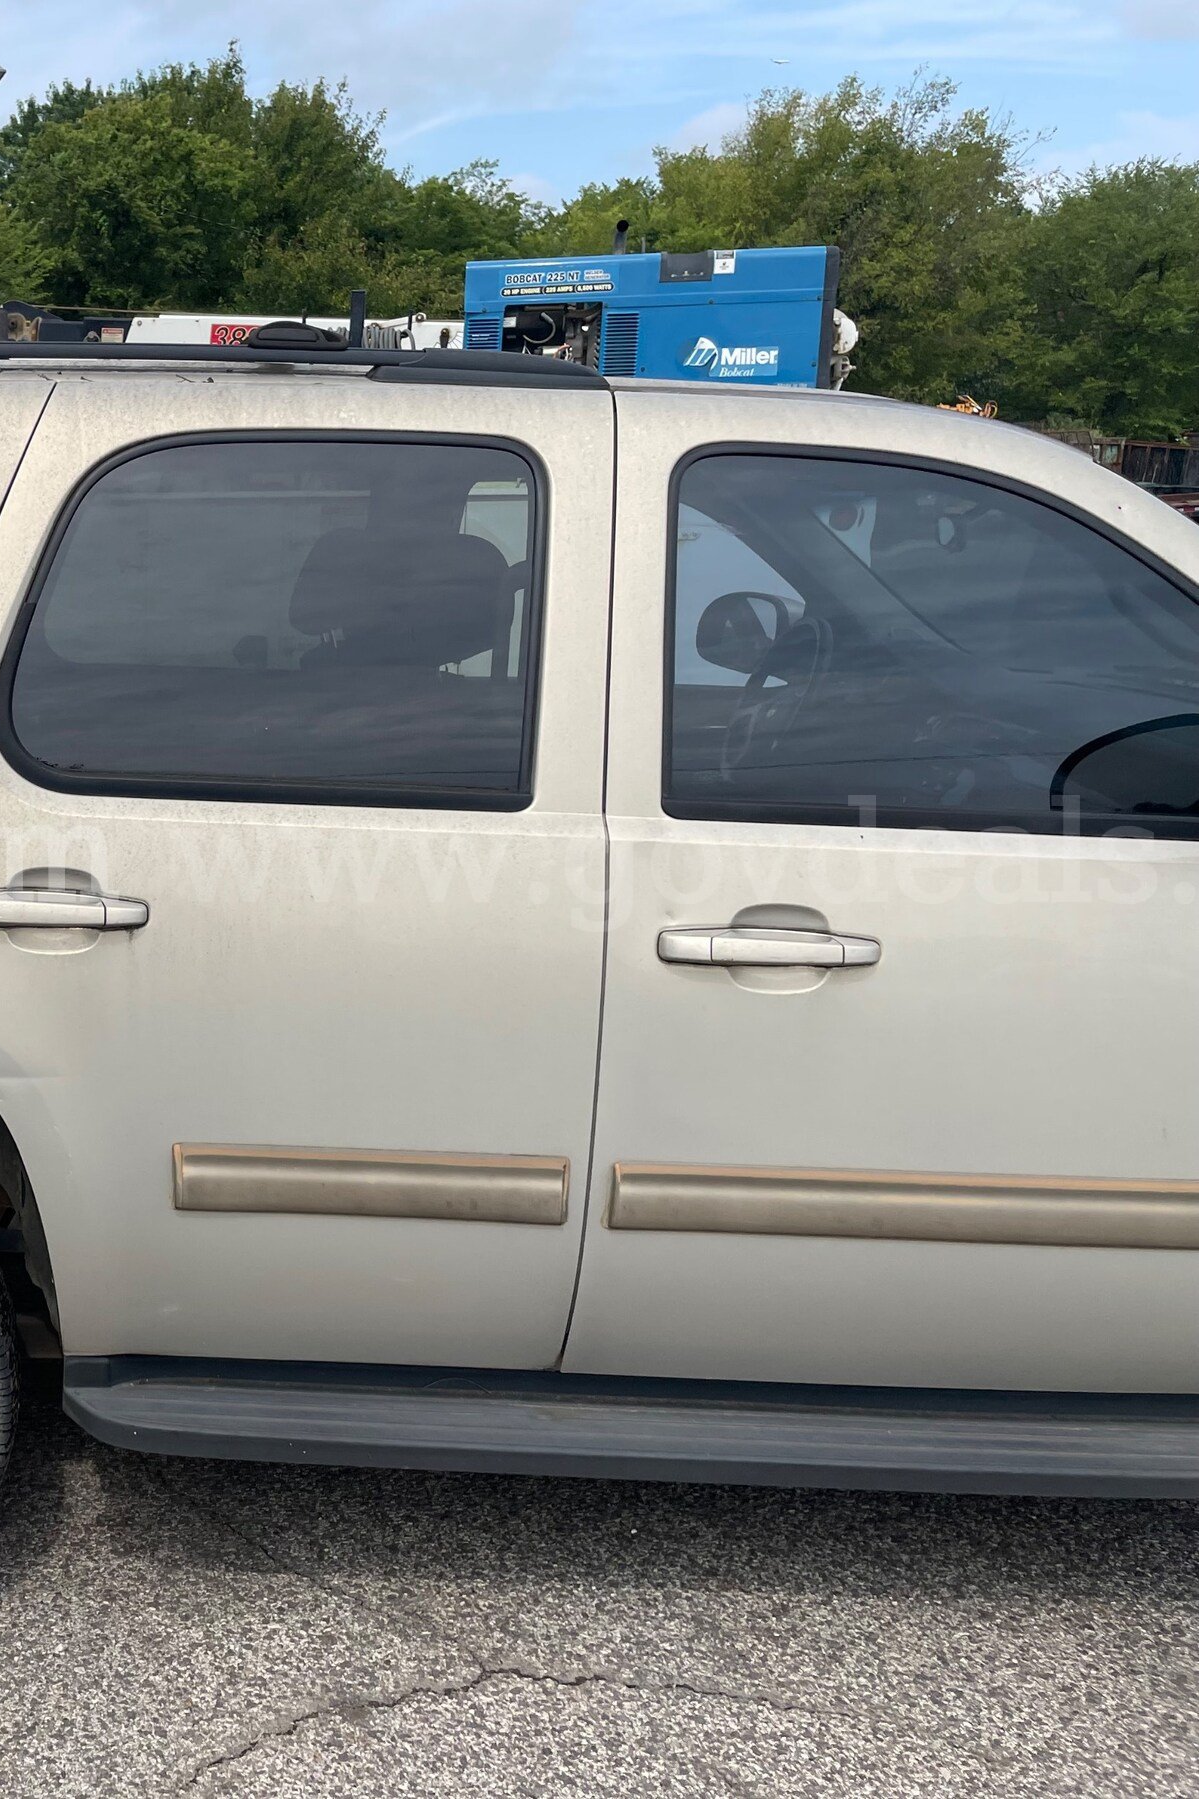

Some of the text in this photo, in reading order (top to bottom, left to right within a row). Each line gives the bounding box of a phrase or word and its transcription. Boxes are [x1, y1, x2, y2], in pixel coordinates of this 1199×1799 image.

[506, 271, 580, 284] BOBCAT 225 NT
[520, 287, 541, 295] ENGINE
[557, 285, 574, 293] AMPS
[593, 283, 612, 291] WATTS
[215, 325, 258, 345] 38
[720, 347, 778, 365] Miller
[719, 367, 755, 377] Bobcat
